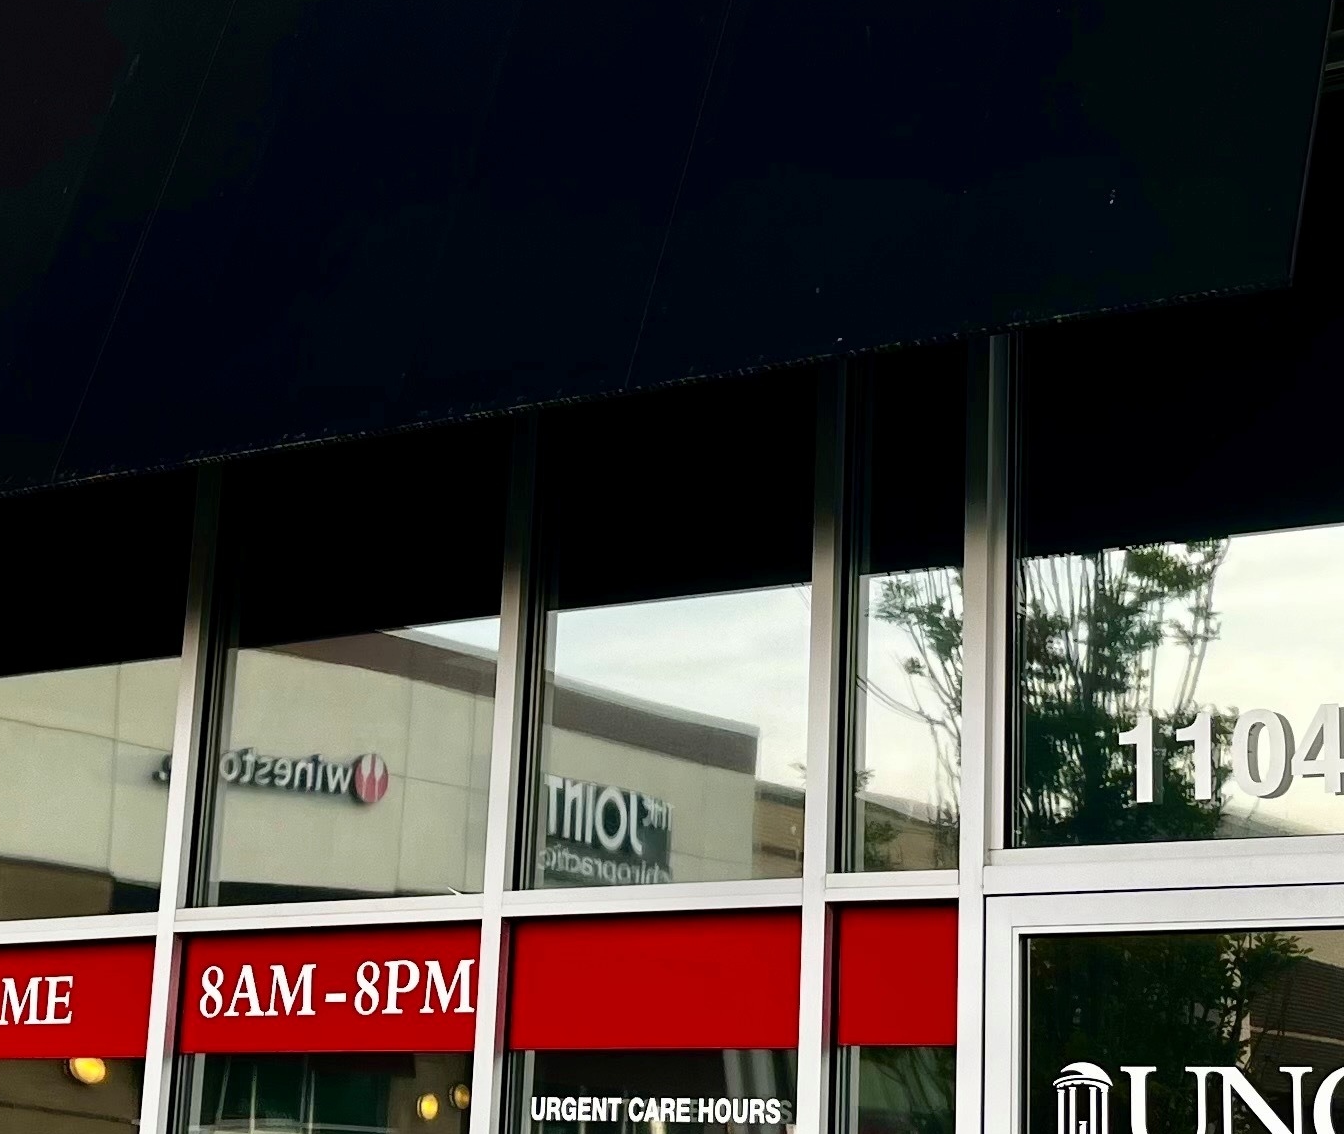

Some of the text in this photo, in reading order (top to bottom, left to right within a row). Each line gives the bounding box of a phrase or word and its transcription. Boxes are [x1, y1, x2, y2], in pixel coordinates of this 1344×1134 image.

[531, 1096, 781, 1124] URGENT CARE HOURS
